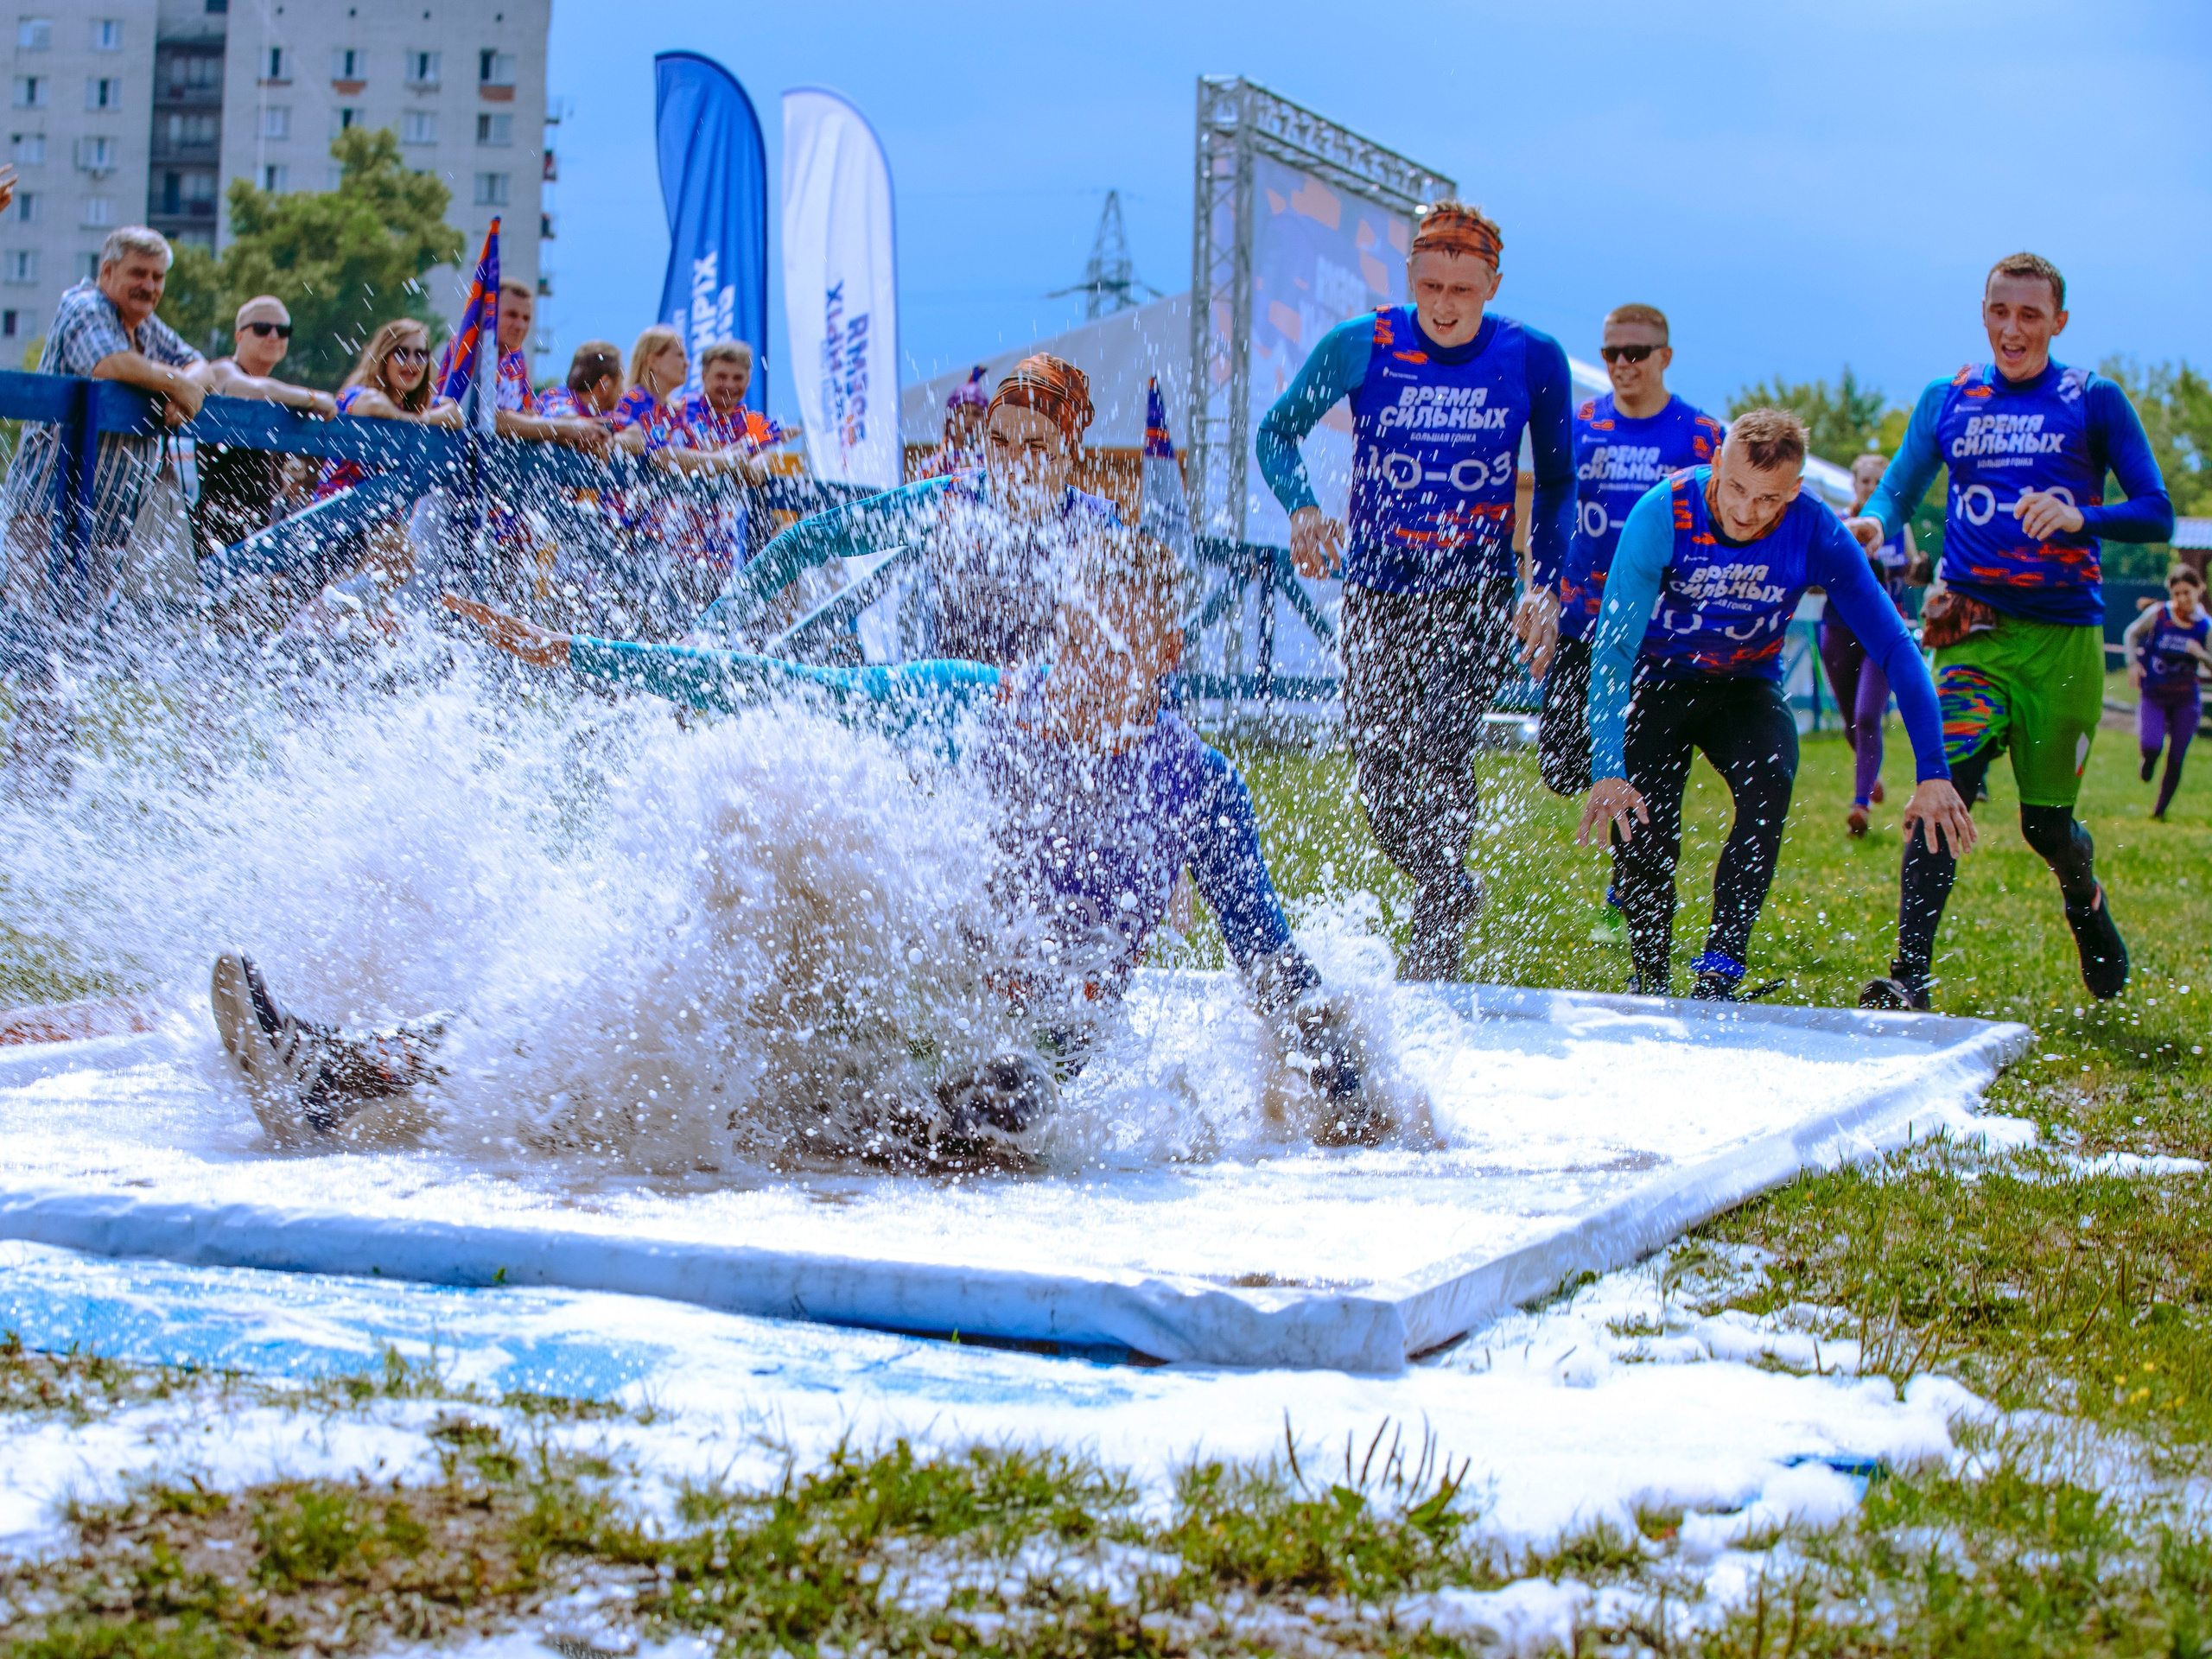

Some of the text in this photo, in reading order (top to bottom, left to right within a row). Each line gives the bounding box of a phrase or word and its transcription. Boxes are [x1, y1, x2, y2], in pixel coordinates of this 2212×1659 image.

[1398, 385, 1488, 408] ВРЕМЯ
[1379, 405, 1510, 429] СИЛЬНЫХ
[1964, 414, 2045, 436] ВРЕМЯ
[1410, 432, 1477, 443] БОЛЬШАЯ ГОНКА
[1952, 432, 2066, 458] СИЛЬНЫХ
[1592, 444, 1661, 464] ВРЕМЯ
[1688, 563, 1770, 582] ВРЕМЯ
[1669, 580, 1787, 603] СИЛЬНЫХ
